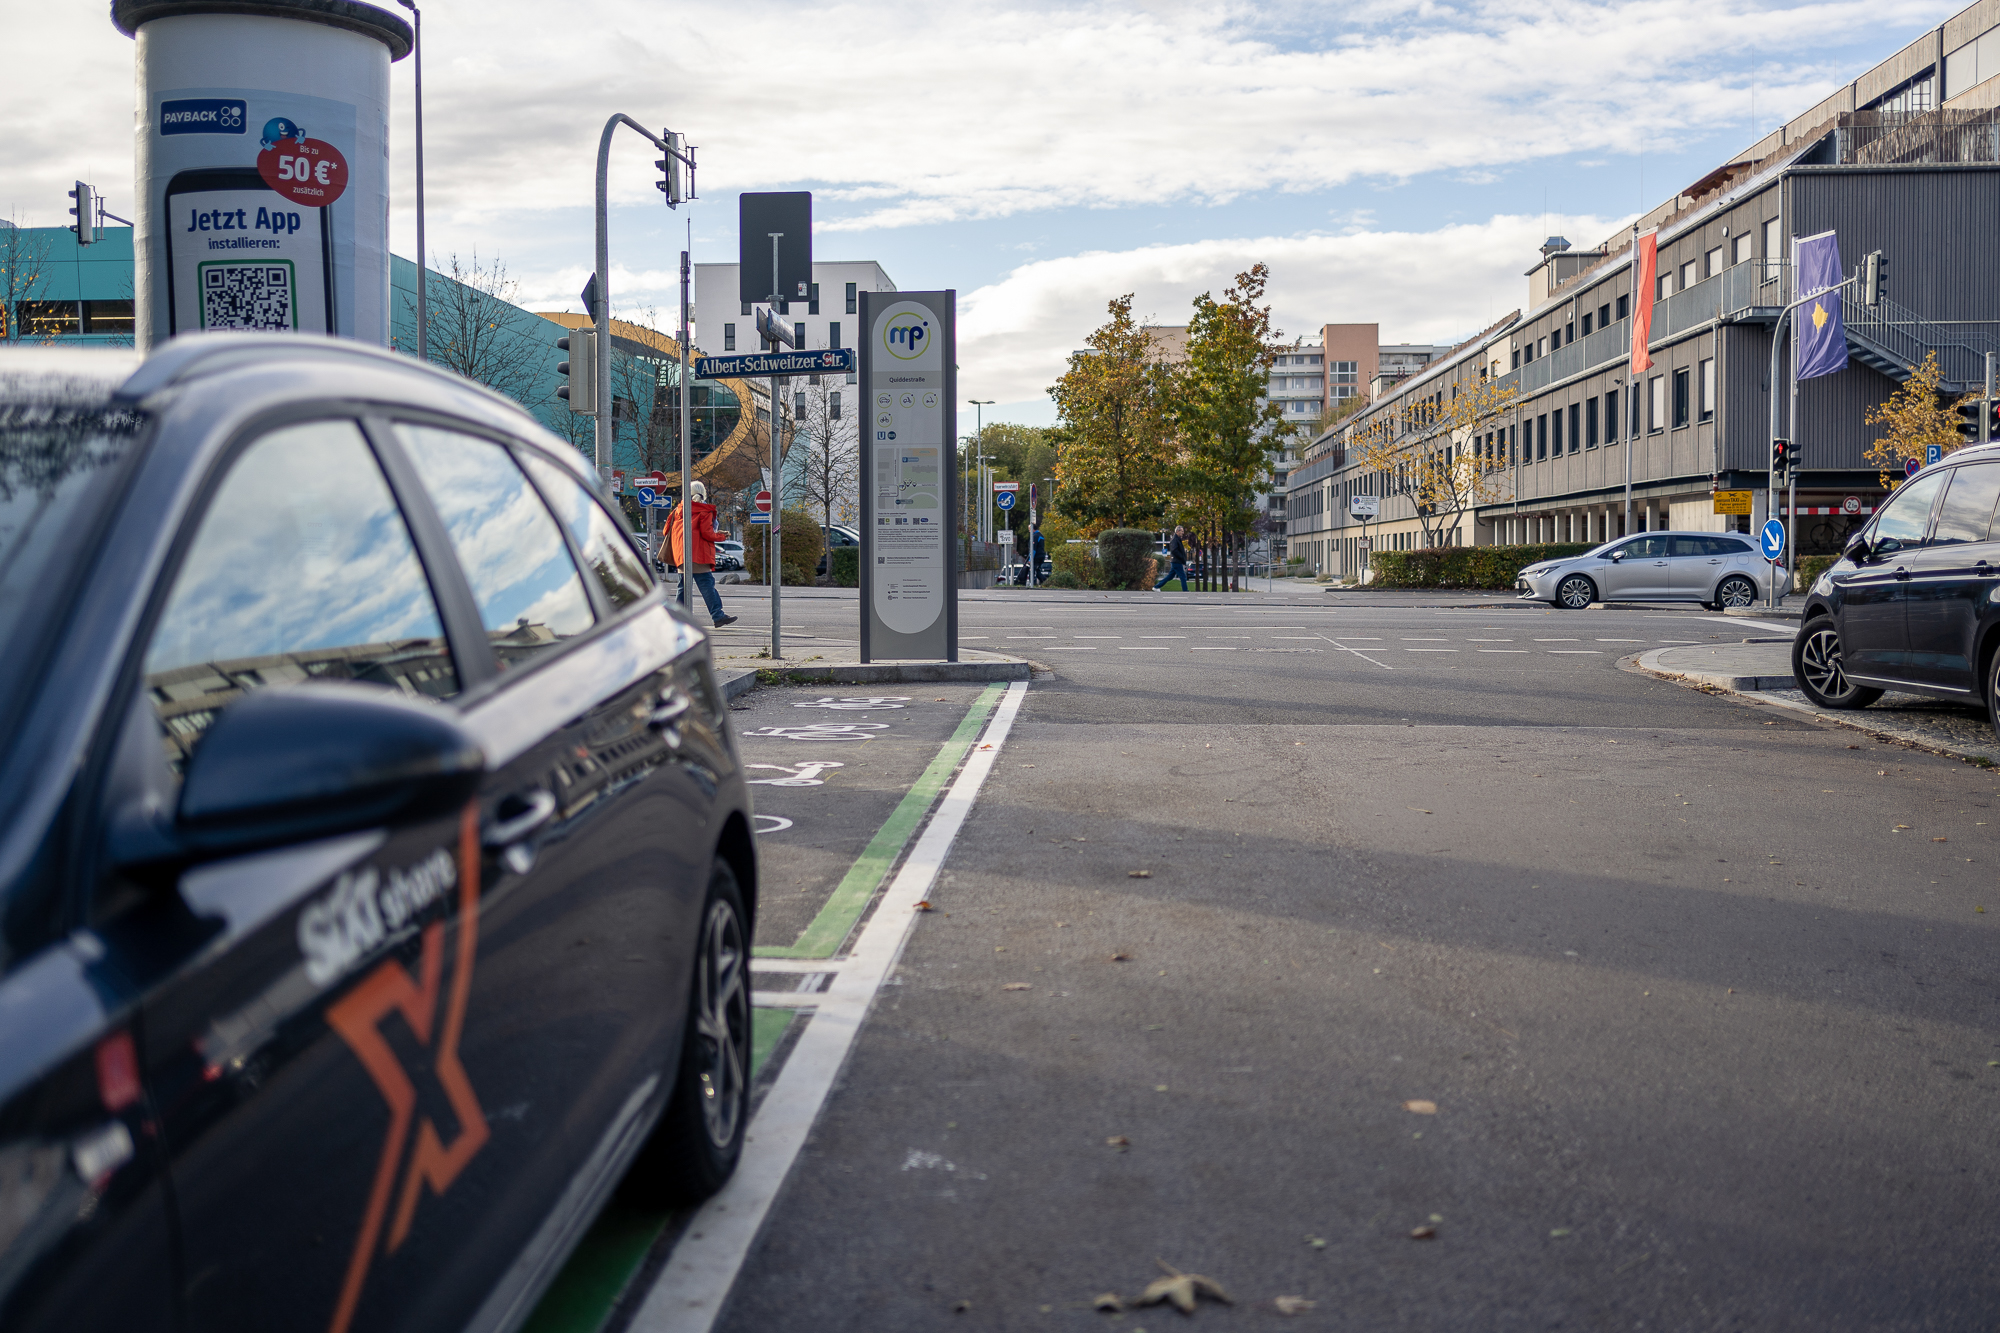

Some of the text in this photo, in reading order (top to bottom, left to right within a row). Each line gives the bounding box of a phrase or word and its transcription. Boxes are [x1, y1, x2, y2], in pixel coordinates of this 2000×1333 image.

[164, 111, 217, 123] PAYBACK
[299, 145, 310, 154] Bis
[278, 155, 310, 182] 50
[293, 187, 324, 196] zusätzlich
[188, 206, 301, 234] Jetzt App
[208, 237, 280, 250] installieren:
[700, 352, 844, 375] Albert-Schweitzer-Str.
[1928, 447, 1937, 463] P
